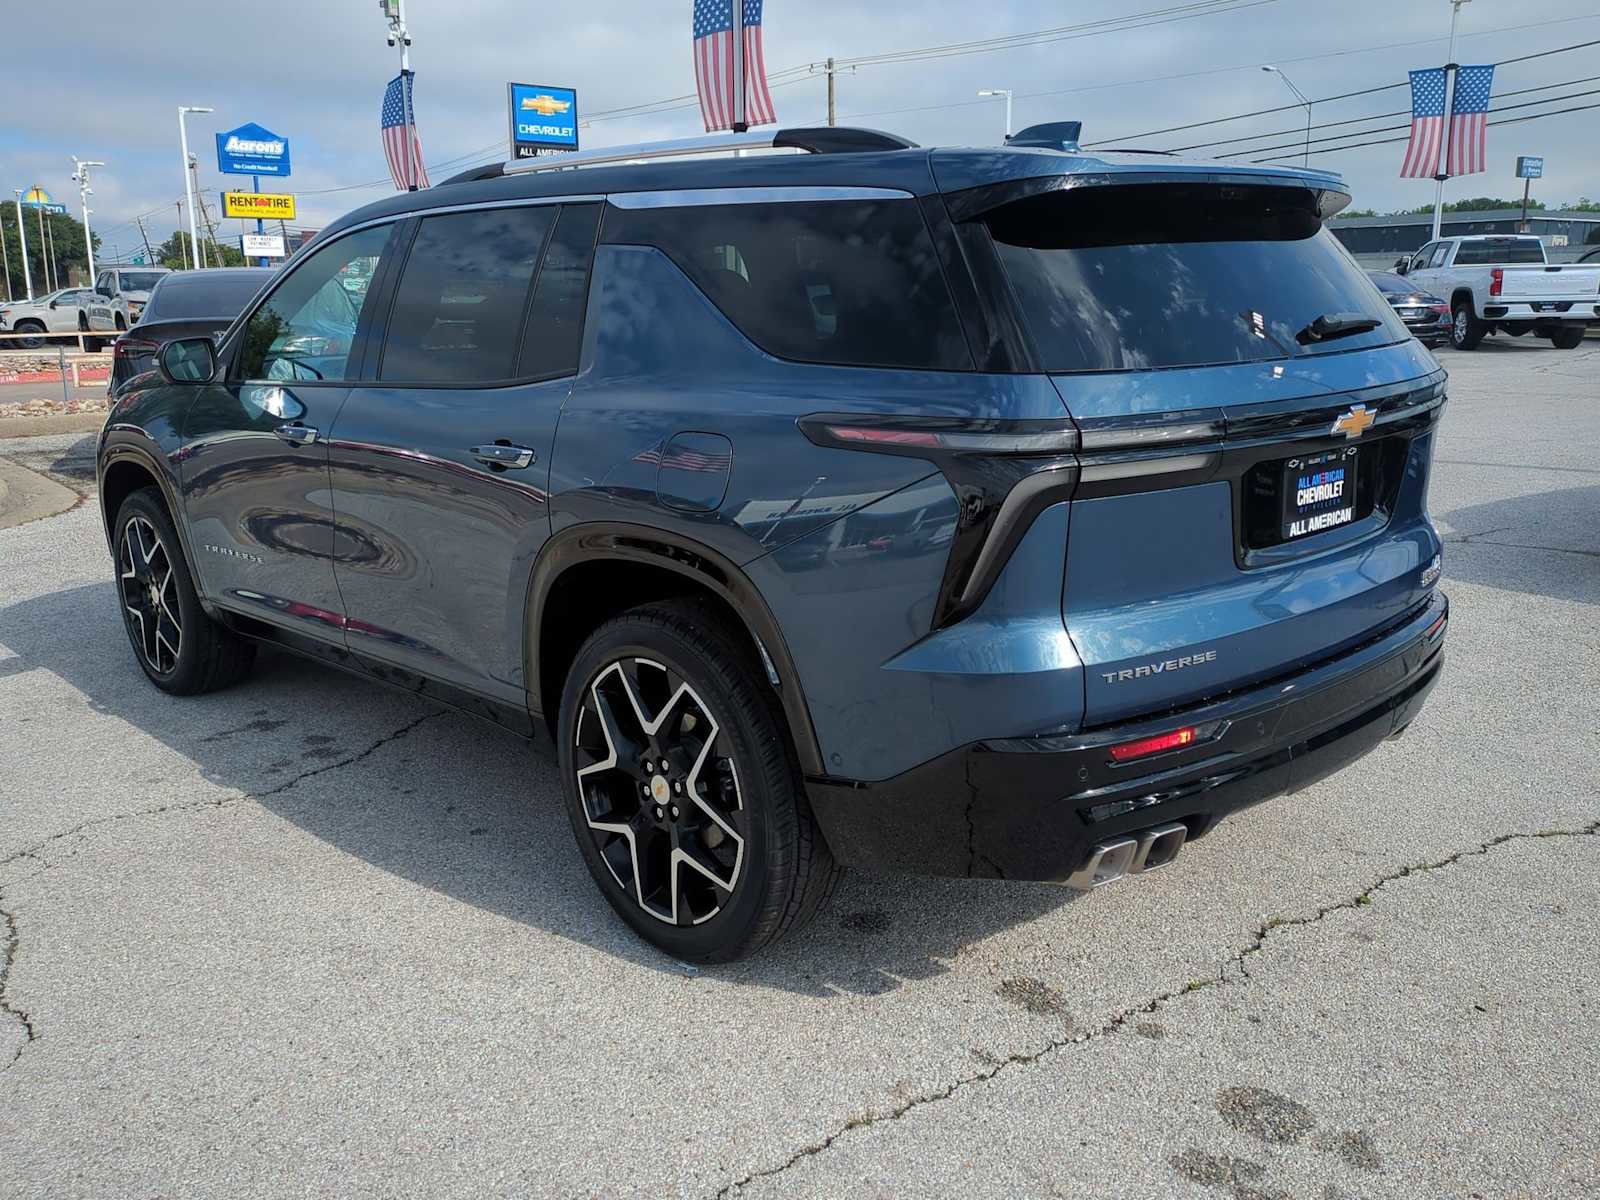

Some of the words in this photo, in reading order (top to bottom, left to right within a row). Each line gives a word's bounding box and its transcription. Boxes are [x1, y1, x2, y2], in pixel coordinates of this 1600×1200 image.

[519, 124, 574, 137] CHEVROLET
[520, 147, 535, 156] ALL
[1298, 476, 1311, 489] ALL
[1312, 468, 1344, 486] AMERICAN
[1297, 480, 1344, 506] CHEVROLET
[1289, 520, 1307, 537] ALL
[1308, 507, 1352, 532] AMERICAN
[1102, 650, 1217, 684] TRAVERSE
